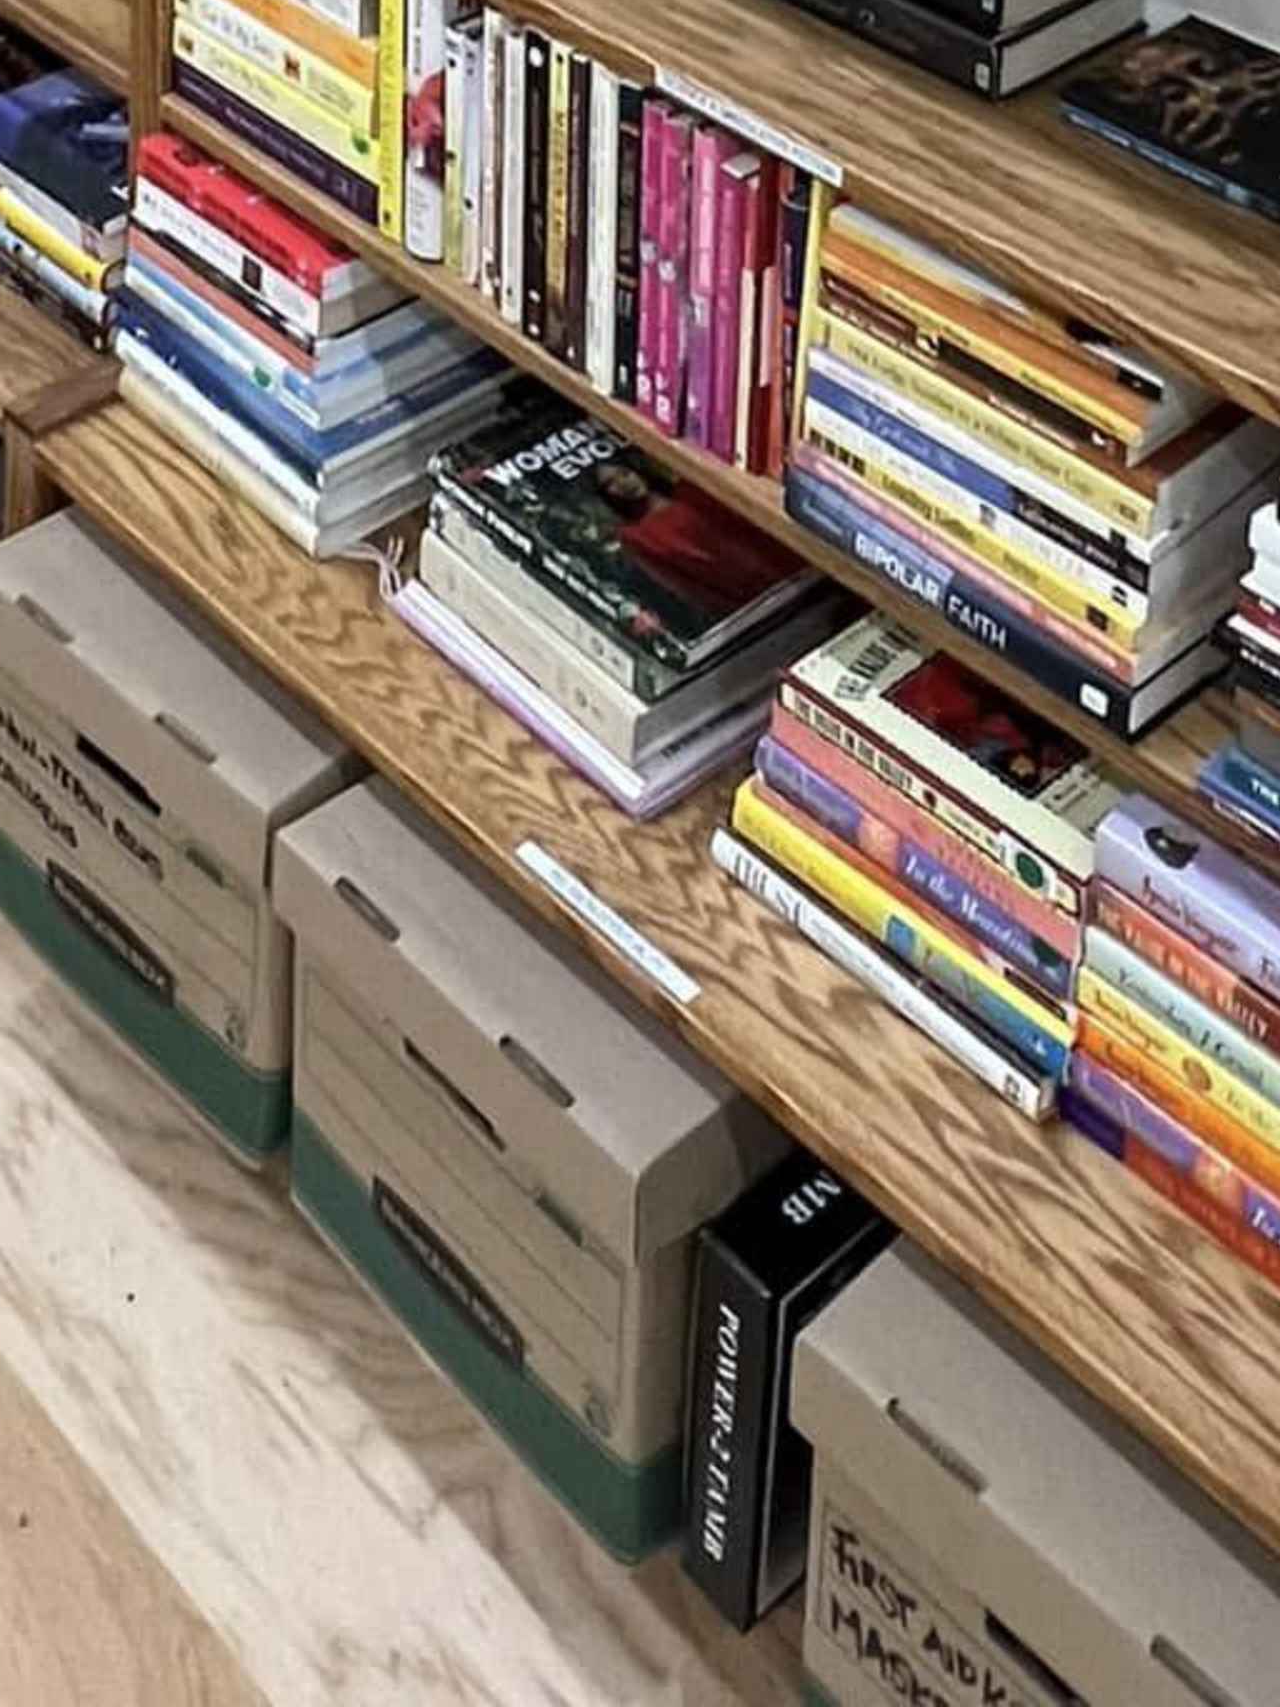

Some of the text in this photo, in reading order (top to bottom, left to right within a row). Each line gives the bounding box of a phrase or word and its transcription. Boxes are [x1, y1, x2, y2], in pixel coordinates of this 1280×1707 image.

[854, 531, 1007, 651] BIPOLAR FAITH
[1249, 779, 1280, 805] THE
